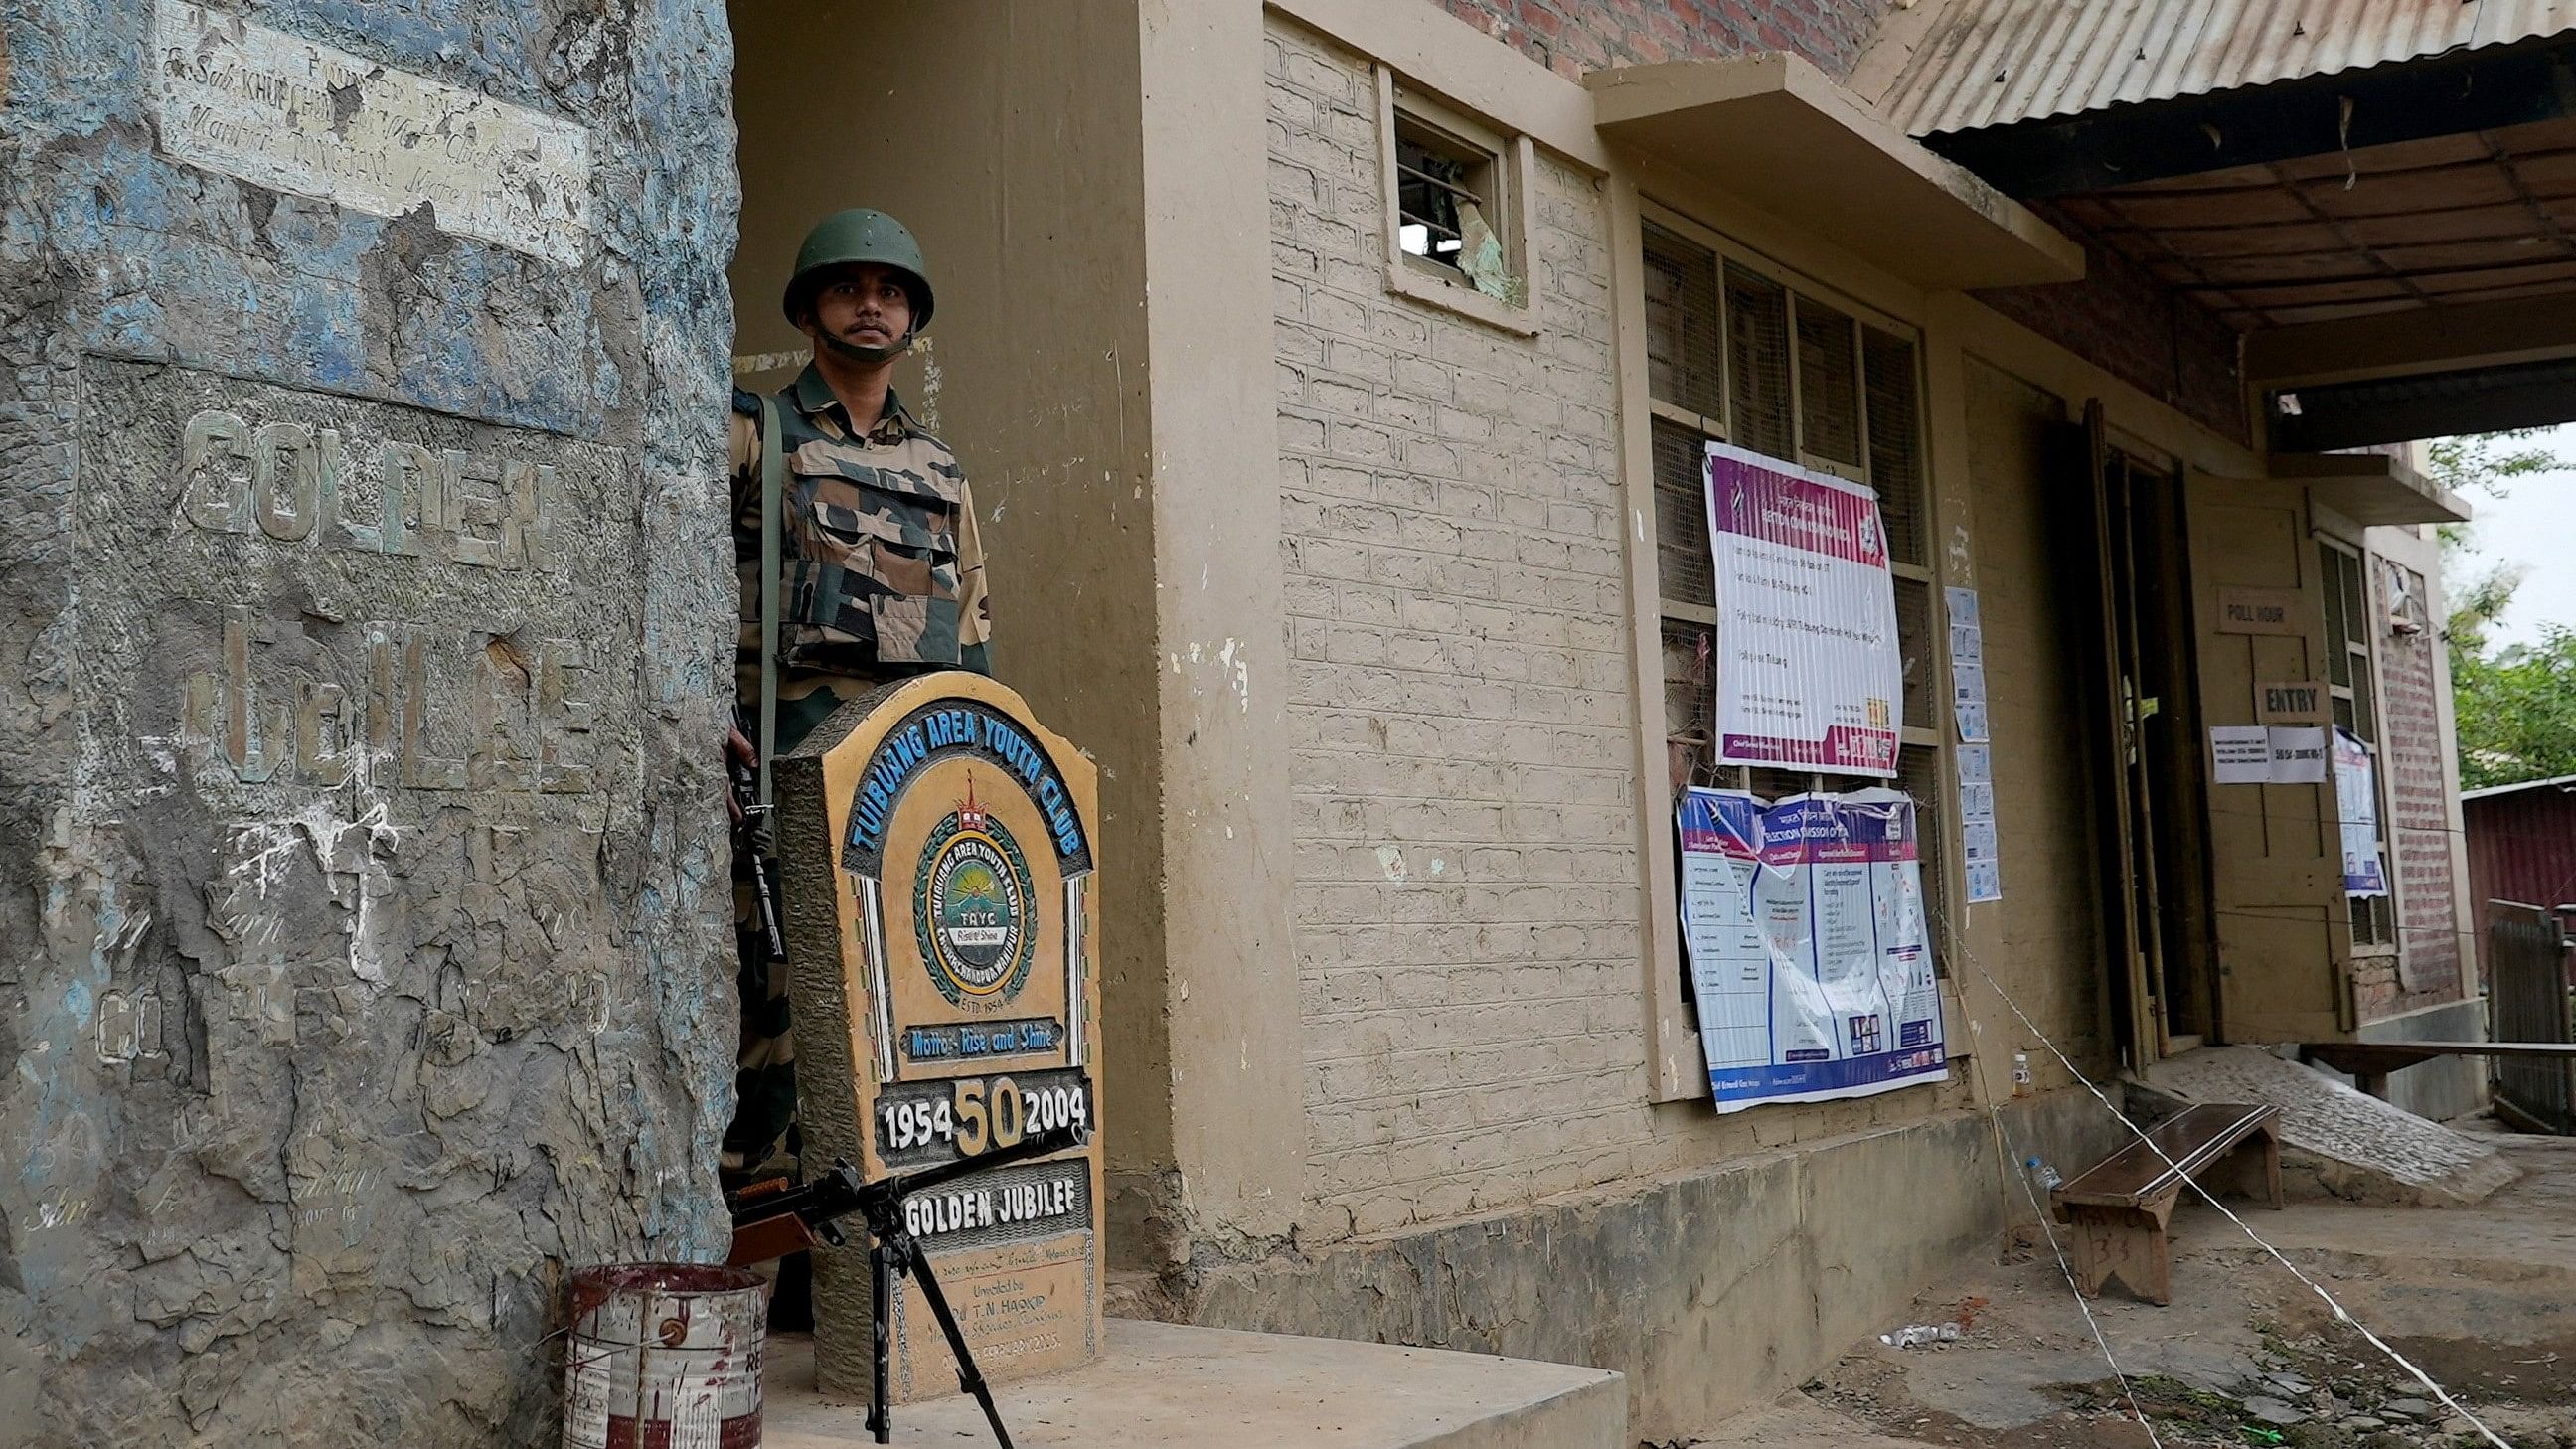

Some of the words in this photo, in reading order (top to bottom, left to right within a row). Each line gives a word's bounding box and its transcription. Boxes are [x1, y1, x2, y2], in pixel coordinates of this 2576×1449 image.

[2227, 604, 2254, 621] POLL
[2256, 605, 2285, 623] HOUR
[2264, 688, 2317, 713] ENTRY
[852, 725, 927, 851] TUIBUANG
[925, 710, 976, 749] AREA
[983, 714, 1043, 784] YOUTH
[1041, 777, 1080, 856] CLUB
[978, 843, 1008, 878] YOUTH
[960, 911, 997, 926] TAYC
[959, 1027, 987, 1053] Rise
[993, 1024, 1016, 1051] and
[1020, 1022, 1053, 1048] Shine
[885, 1100, 953, 1149] 1954
[954, 1076, 1023, 1157] 50
[1025, 1087, 1086, 1134] 2004
[905, 1191, 993, 1237] GOLDEN
[998, 1179, 1076, 1223] JUBILEE
